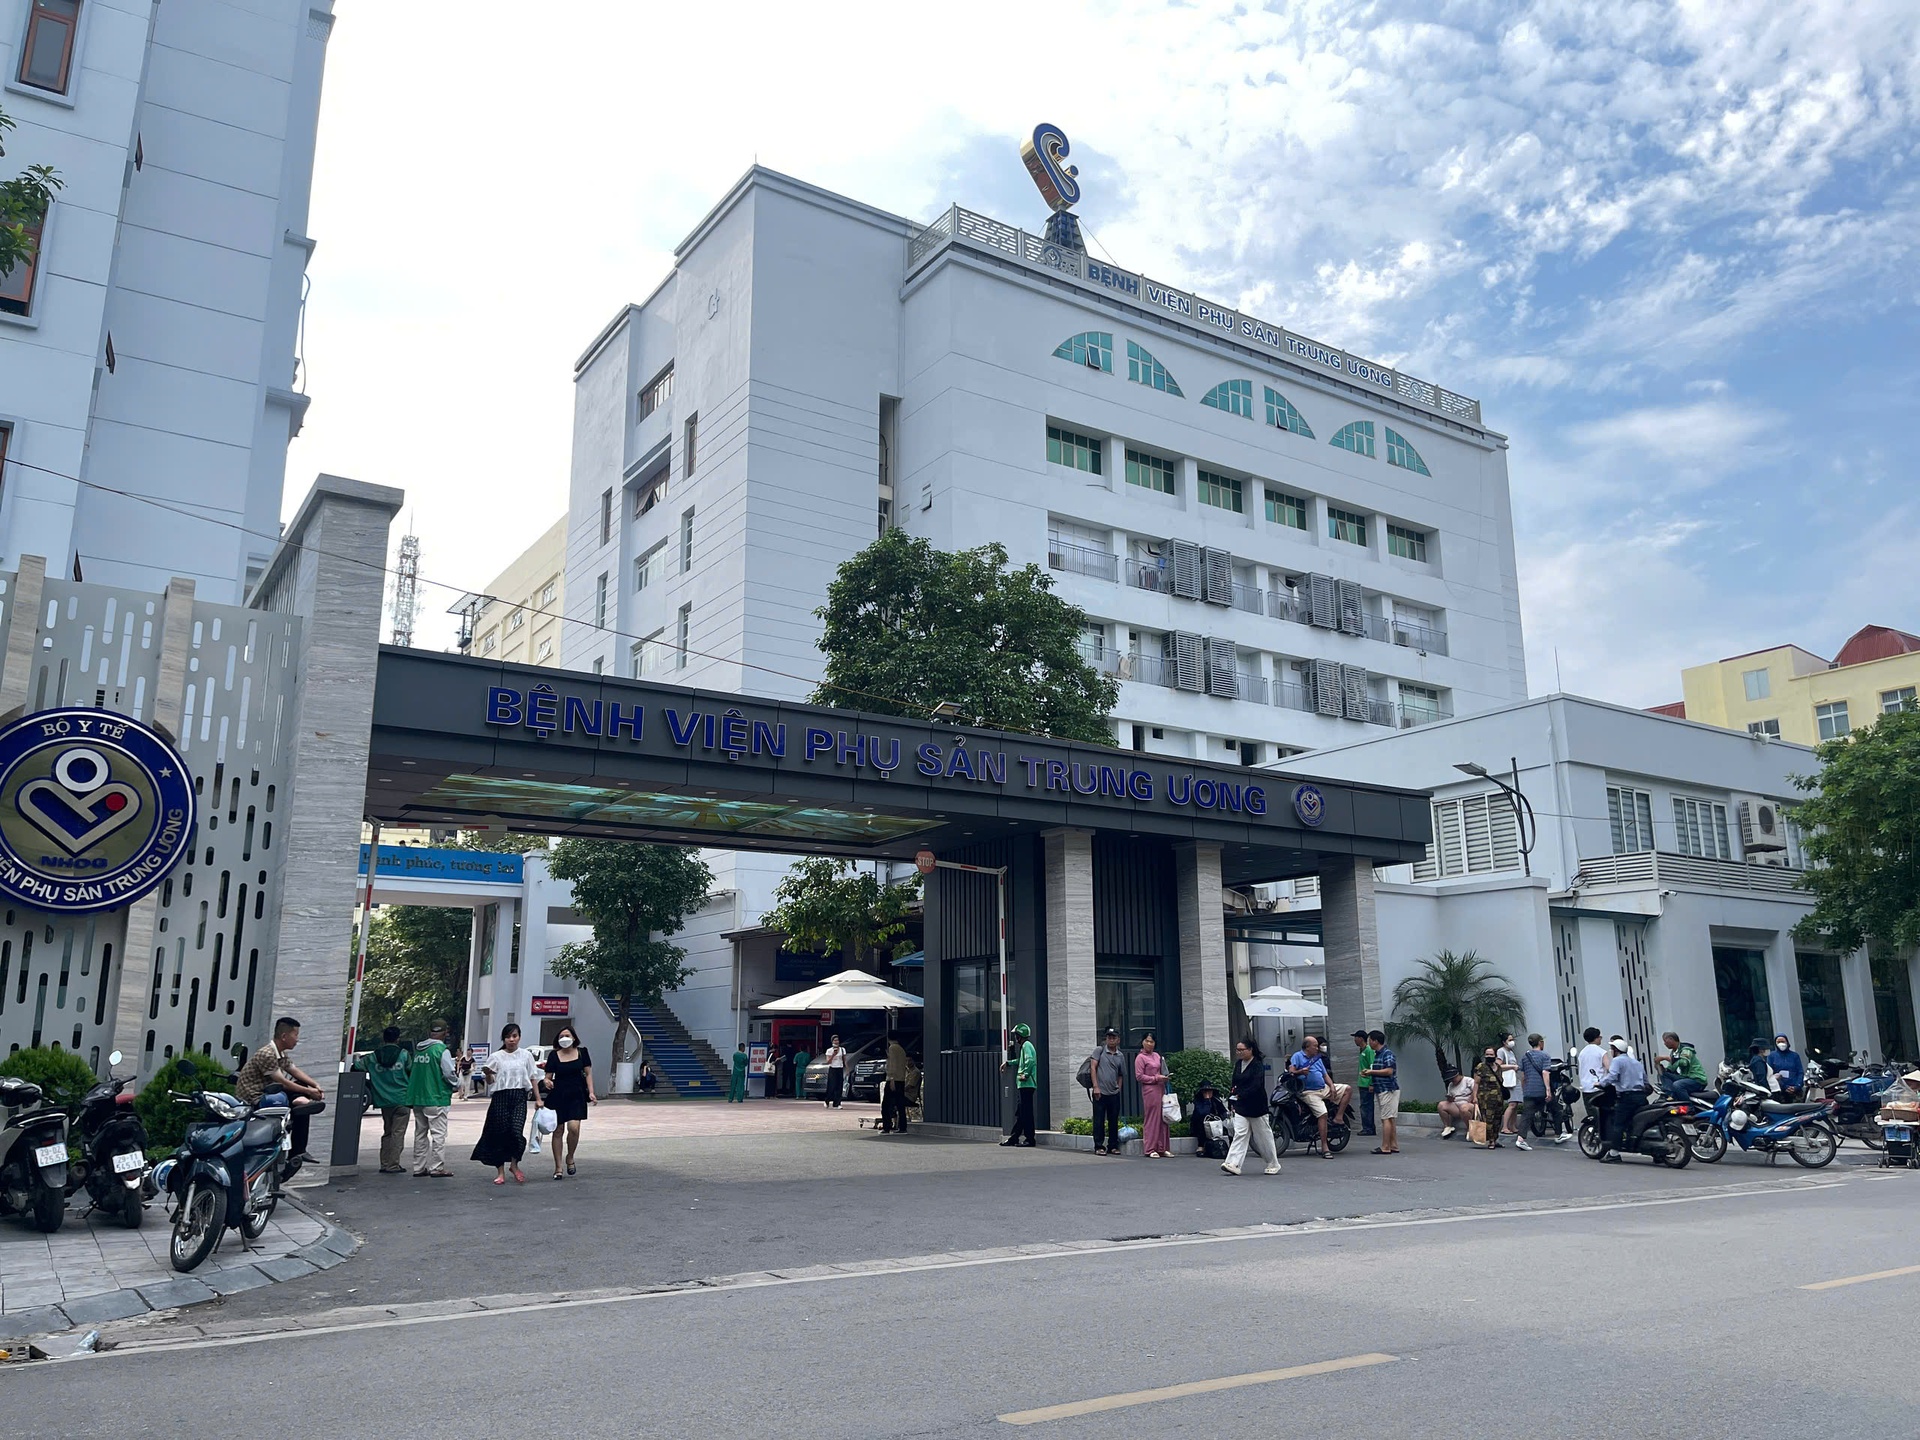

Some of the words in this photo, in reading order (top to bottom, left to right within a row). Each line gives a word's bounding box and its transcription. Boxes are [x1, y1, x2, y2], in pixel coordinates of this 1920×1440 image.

[1088, 264, 1138, 296] BỆNH
[1147, 284, 1191, 316] VIỆN
[1198, 304, 1234, 332] PHỤ
[1241, 320, 1279, 347] SẢN
[1286, 337, 1341, 369] TRUNG
[1347, 359, 1392, 388] ƯƠNG
[41, 718, 71, 736] BỘ
[78, 720, 93, 733] Y
[100, 723, 129, 740] TẾ
[486, 683, 645, 741] BỆNH
[664, 708, 787, 761] VIỆN
[805, 726, 900, 778] PHỤ
[917, 734, 1007, 784] SẢN
[1019, 755, 1154, 800] TRUNG
[1167, 773, 1268, 815] ƯƠNG
[19, 876, 60, 903] PHỤ
[63, 882, 103, 901] SẢN
[104, 854, 162, 895] TRUNG
[155, 808, 184, 854] ƯƠNG
[40, 855, 108, 869] NHOG
